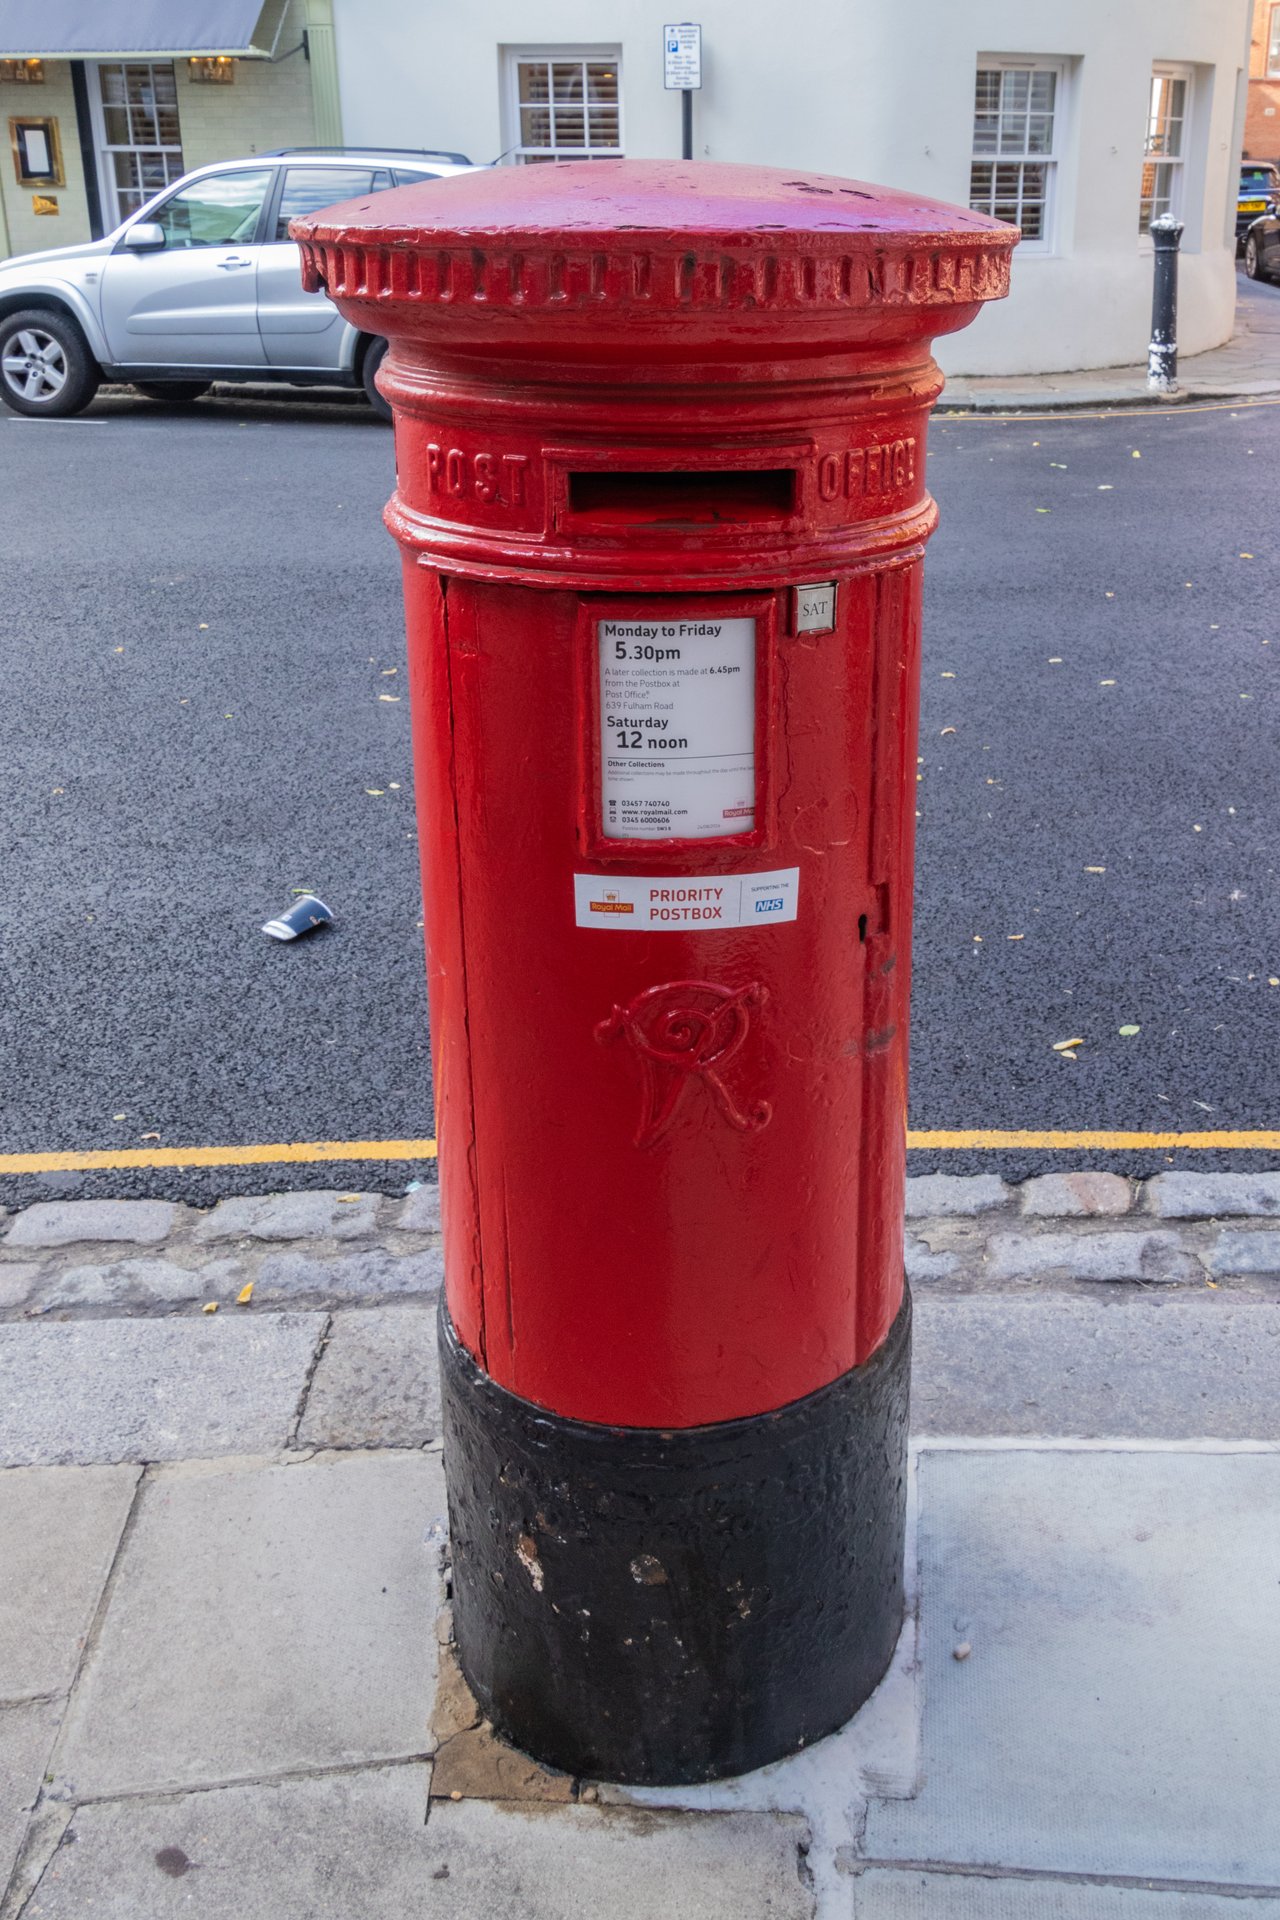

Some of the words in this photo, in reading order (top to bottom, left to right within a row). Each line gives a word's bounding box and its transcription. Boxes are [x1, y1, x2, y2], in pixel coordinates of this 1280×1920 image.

[426, 443, 528, 505] POST
[819, 437, 916, 502] OFFICE
[802, 601, 828, 617] SAT
[605, 624, 658, 639] Monday
[662, 626, 675, 637] to
[679, 624, 722, 638] Friday
[615, 641, 680, 663] 5.30pm
[605, 668, 611, 676] A
[612, 668, 629, 676] later
[631, 668, 668, 676] collection
[677, 668, 699, 677] made
[709, 666, 740, 675] 6.45pm
[640, 680, 671, 688] Postbox
[672, 680, 680, 688] at
[605, 690, 623, 698] Post
[606, 702, 621, 710] 639
[624, 701, 652, 710] Fulham
[654, 702, 674, 710] Road
[607, 716, 669, 731] Saturday
[616, 730, 643, 749] 12
[647, 737, 688, 749] noon
[724, 809, 742, 817] Royal
[649, 888, 723, 902] PRIORITY
[591, 902, 614, 912] Royal
[756, 898, 782, 912] NHS
[649, 907, 722, 920] POSTBOX
